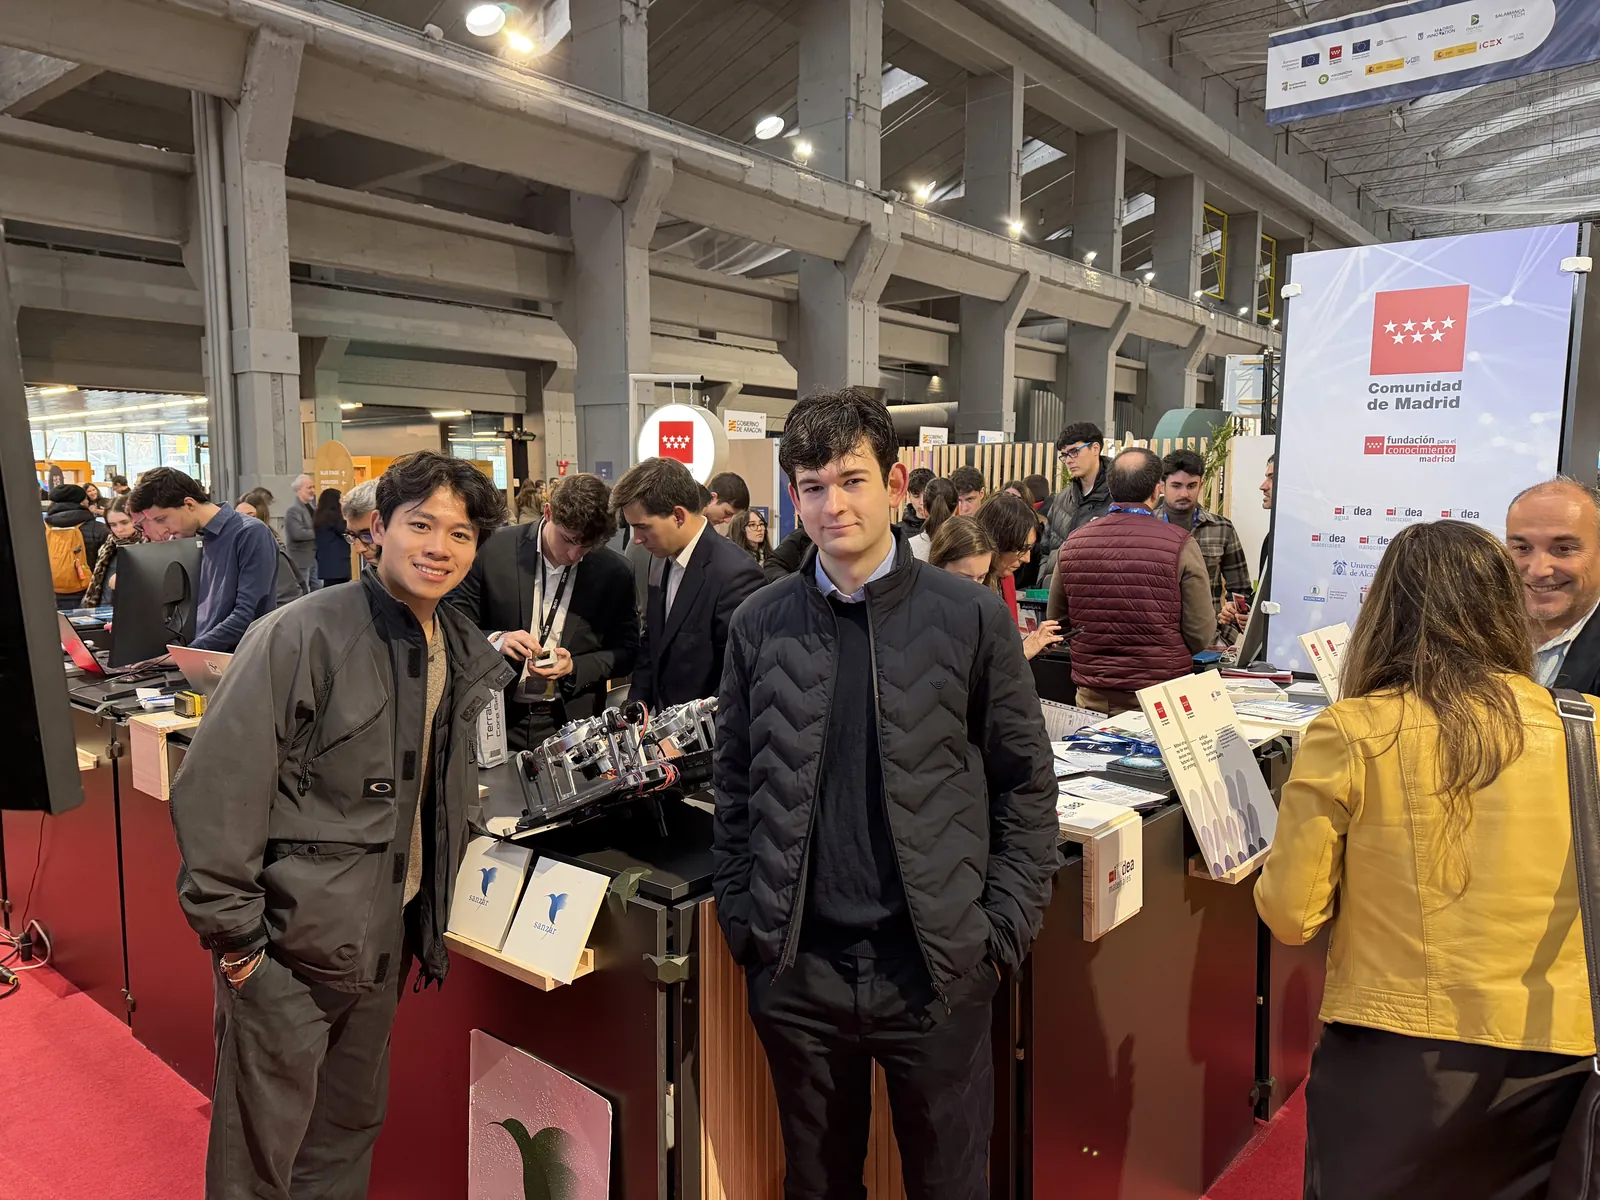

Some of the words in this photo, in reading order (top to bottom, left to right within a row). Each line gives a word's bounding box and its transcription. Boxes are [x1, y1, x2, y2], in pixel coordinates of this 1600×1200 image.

[1368, 380, 1462, 394] Comunidad
[1367, 398, 1389, 410] de
[1395, 396, 1461, 410] Madrid
[1387, 435, 1435, 444] fundación
[1387, 445, 1454, 454] conocimiento
